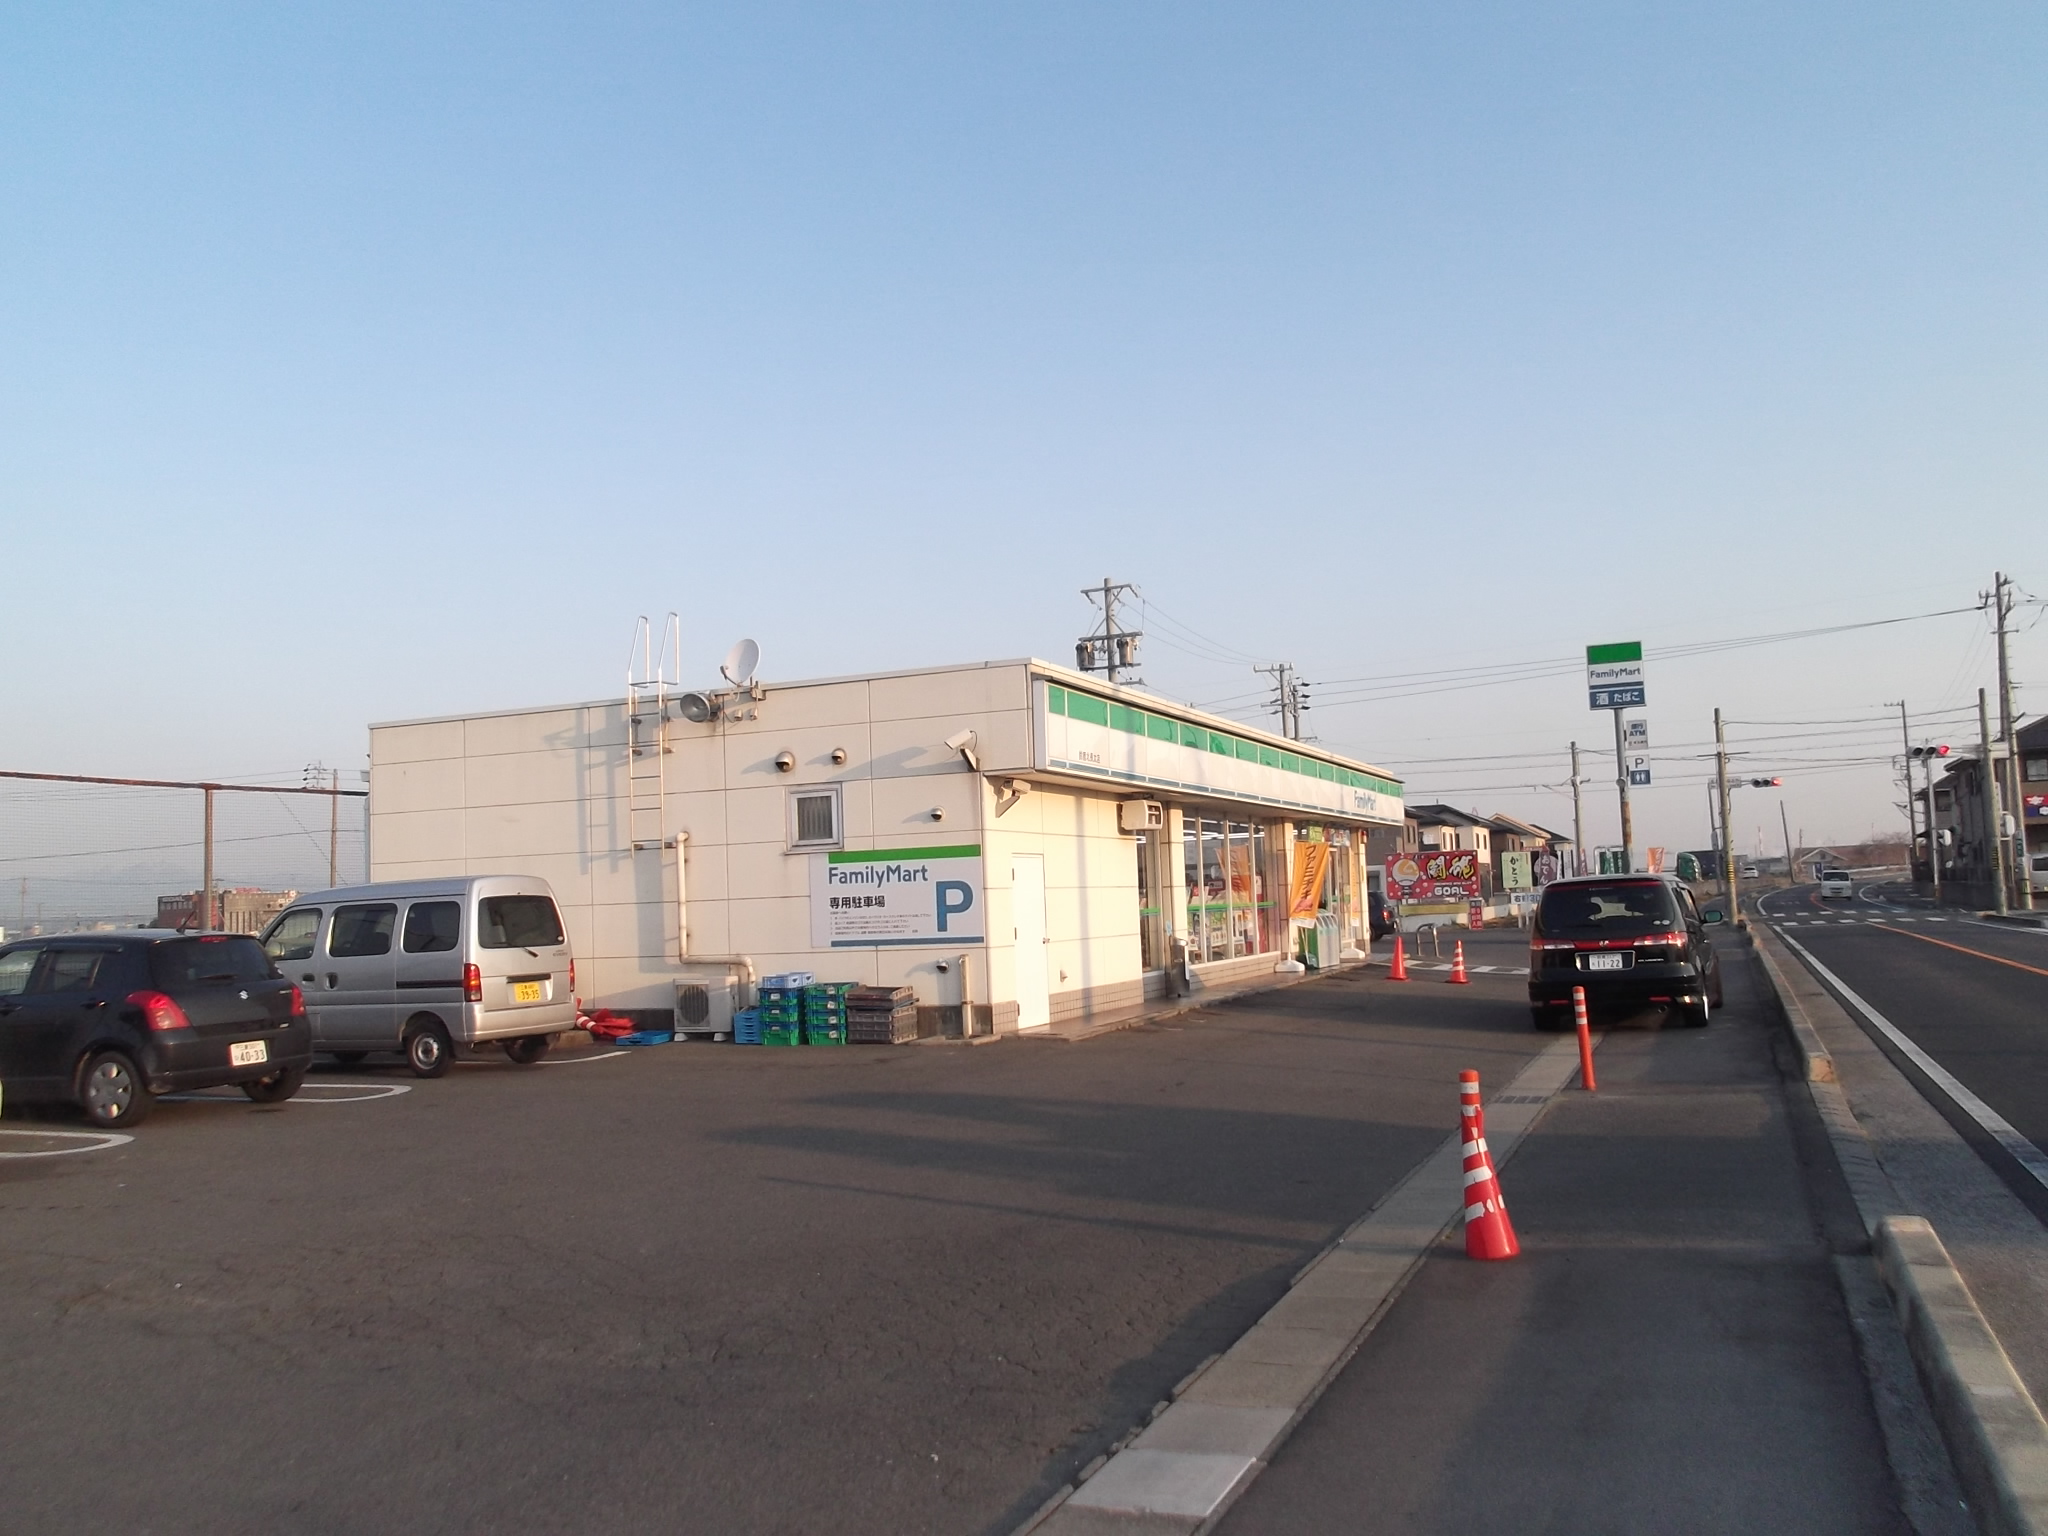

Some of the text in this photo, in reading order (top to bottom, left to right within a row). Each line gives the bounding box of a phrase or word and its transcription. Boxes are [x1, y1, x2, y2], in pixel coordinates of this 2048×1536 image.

[1590, 667, 1641, 679] FamilyMart
[1596, 692, 1640, 705] 酒 たばこ
[1628, 729, 1646, 737] ATM
[1634, 757, 1645, 769] P
[828, 864, 929, 888] FamilyMart
[1509, 855, 1519, 886] かとう
[1434, 886, 1469, 896] GOAL
[829, 895, 886, 909] 専用駐車場
[935, 880, 974, 932] P
[1597, 959, 1621, 968] 11-22
[240, 1049, 265, 1062] 40-33
